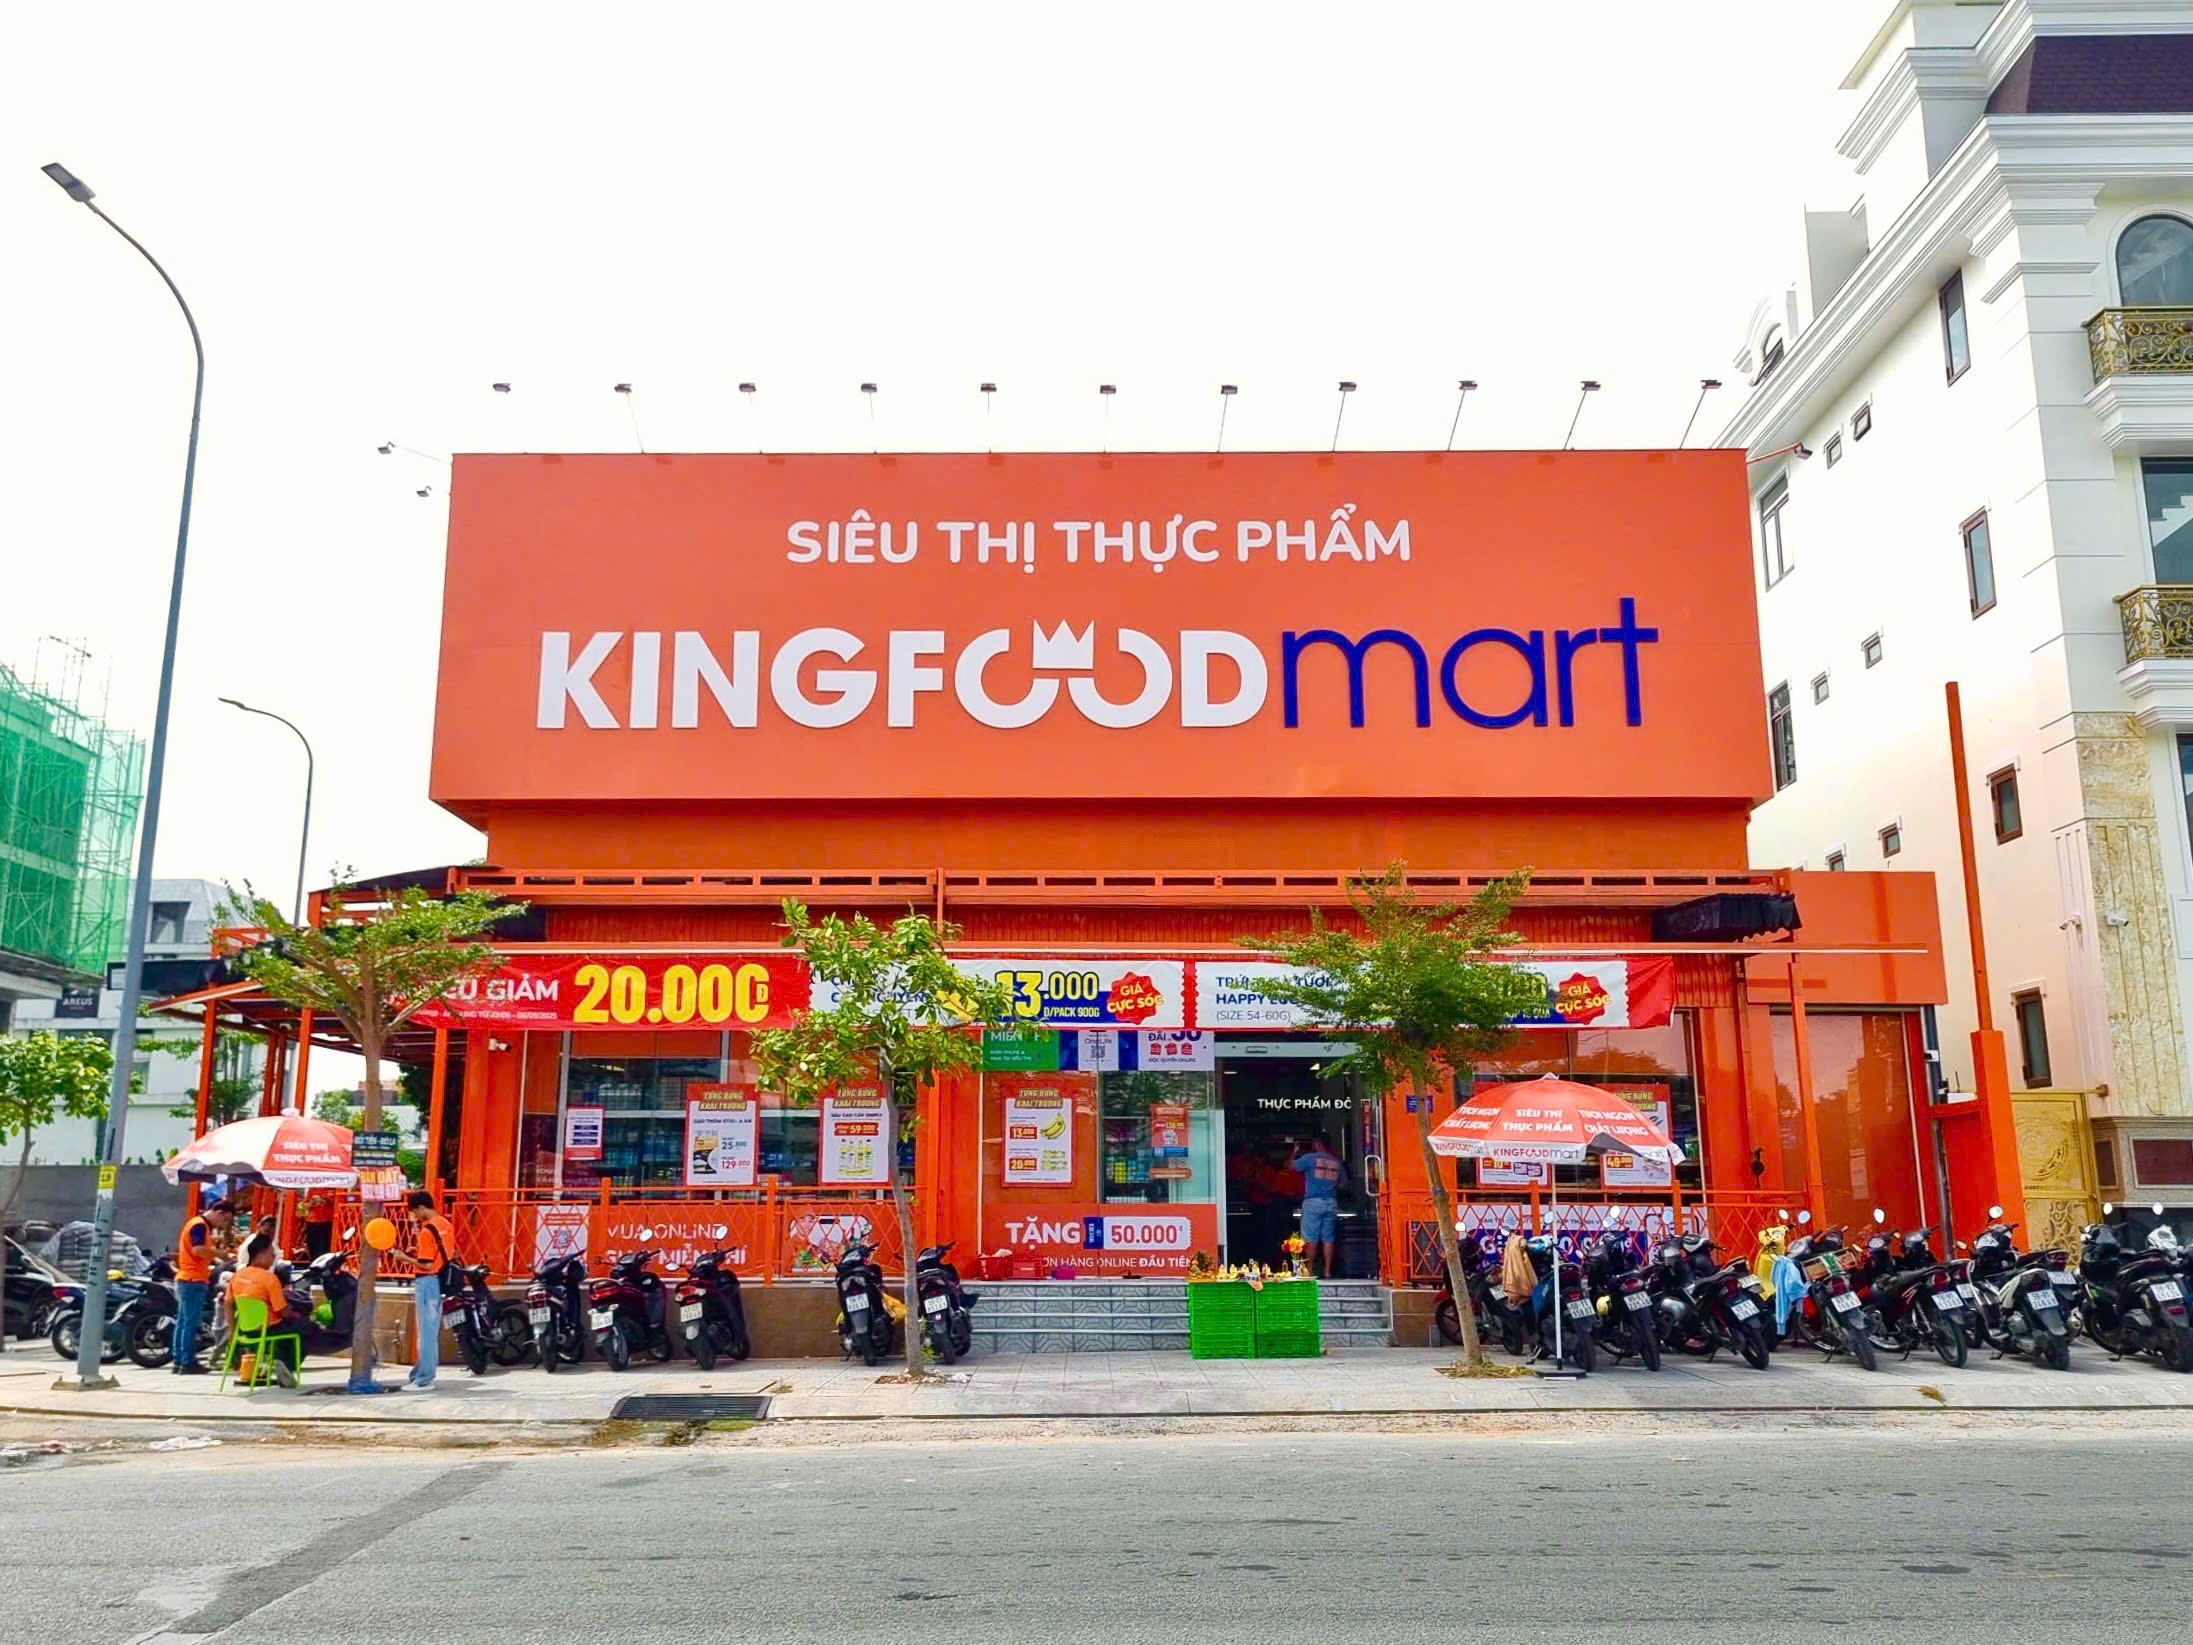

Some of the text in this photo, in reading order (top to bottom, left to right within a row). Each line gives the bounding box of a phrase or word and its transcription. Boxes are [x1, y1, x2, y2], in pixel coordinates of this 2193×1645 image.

[787, 503, 1411, 574] SIÊU THỊ THỰC PHẨM
[486, 973, 559, 1001] GIẢM
[1120, 982, 1144, 995] GIÁ
[1568, 982, 1592, 996] GIÁ
[1216, 993, 1264, 1005] HAPPY
[1043, 1007, 1100, 1018] Đ/PACK 900G
[1216, 1010, 1291, 1021] (SIZE 54-60G)
[1004, 1215, 1081, 1250] TẶNG
